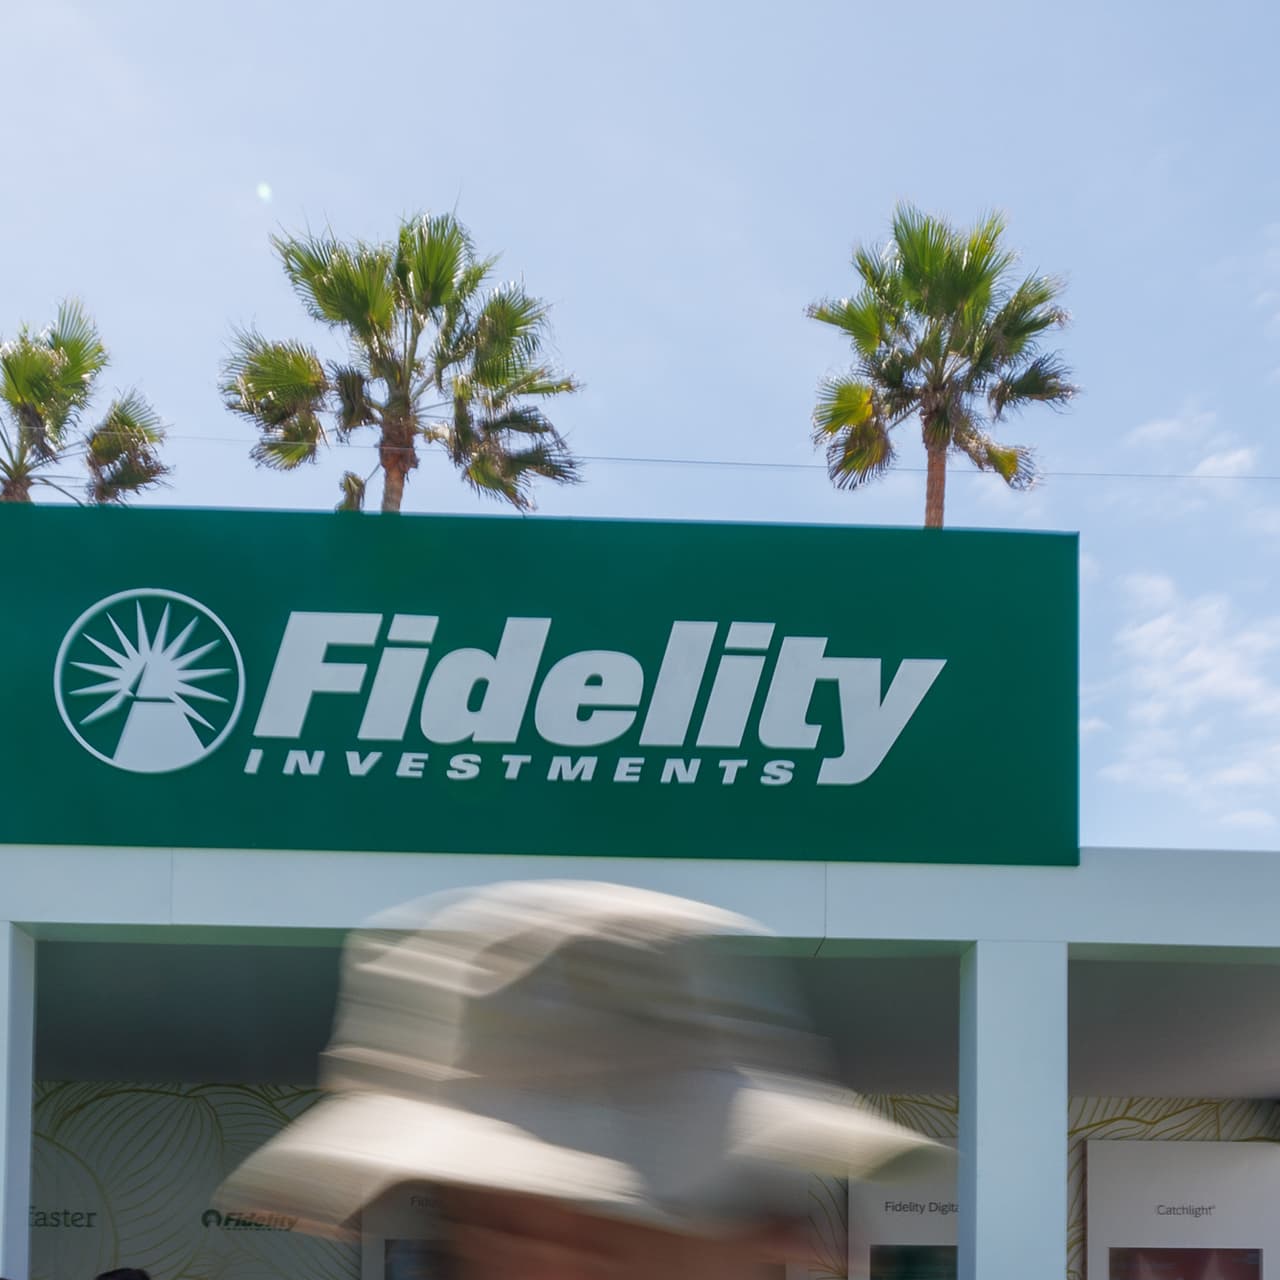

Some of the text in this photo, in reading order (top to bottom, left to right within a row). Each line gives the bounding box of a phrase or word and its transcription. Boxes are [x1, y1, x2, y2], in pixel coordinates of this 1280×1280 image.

[252, 610, 948, 786] Fidelity
[242, 747, 796, 785] INVESTMENTS
[223, 1212, 298, 1232] Fidelity
[884, 1201, 926, 1215] Fidelity
